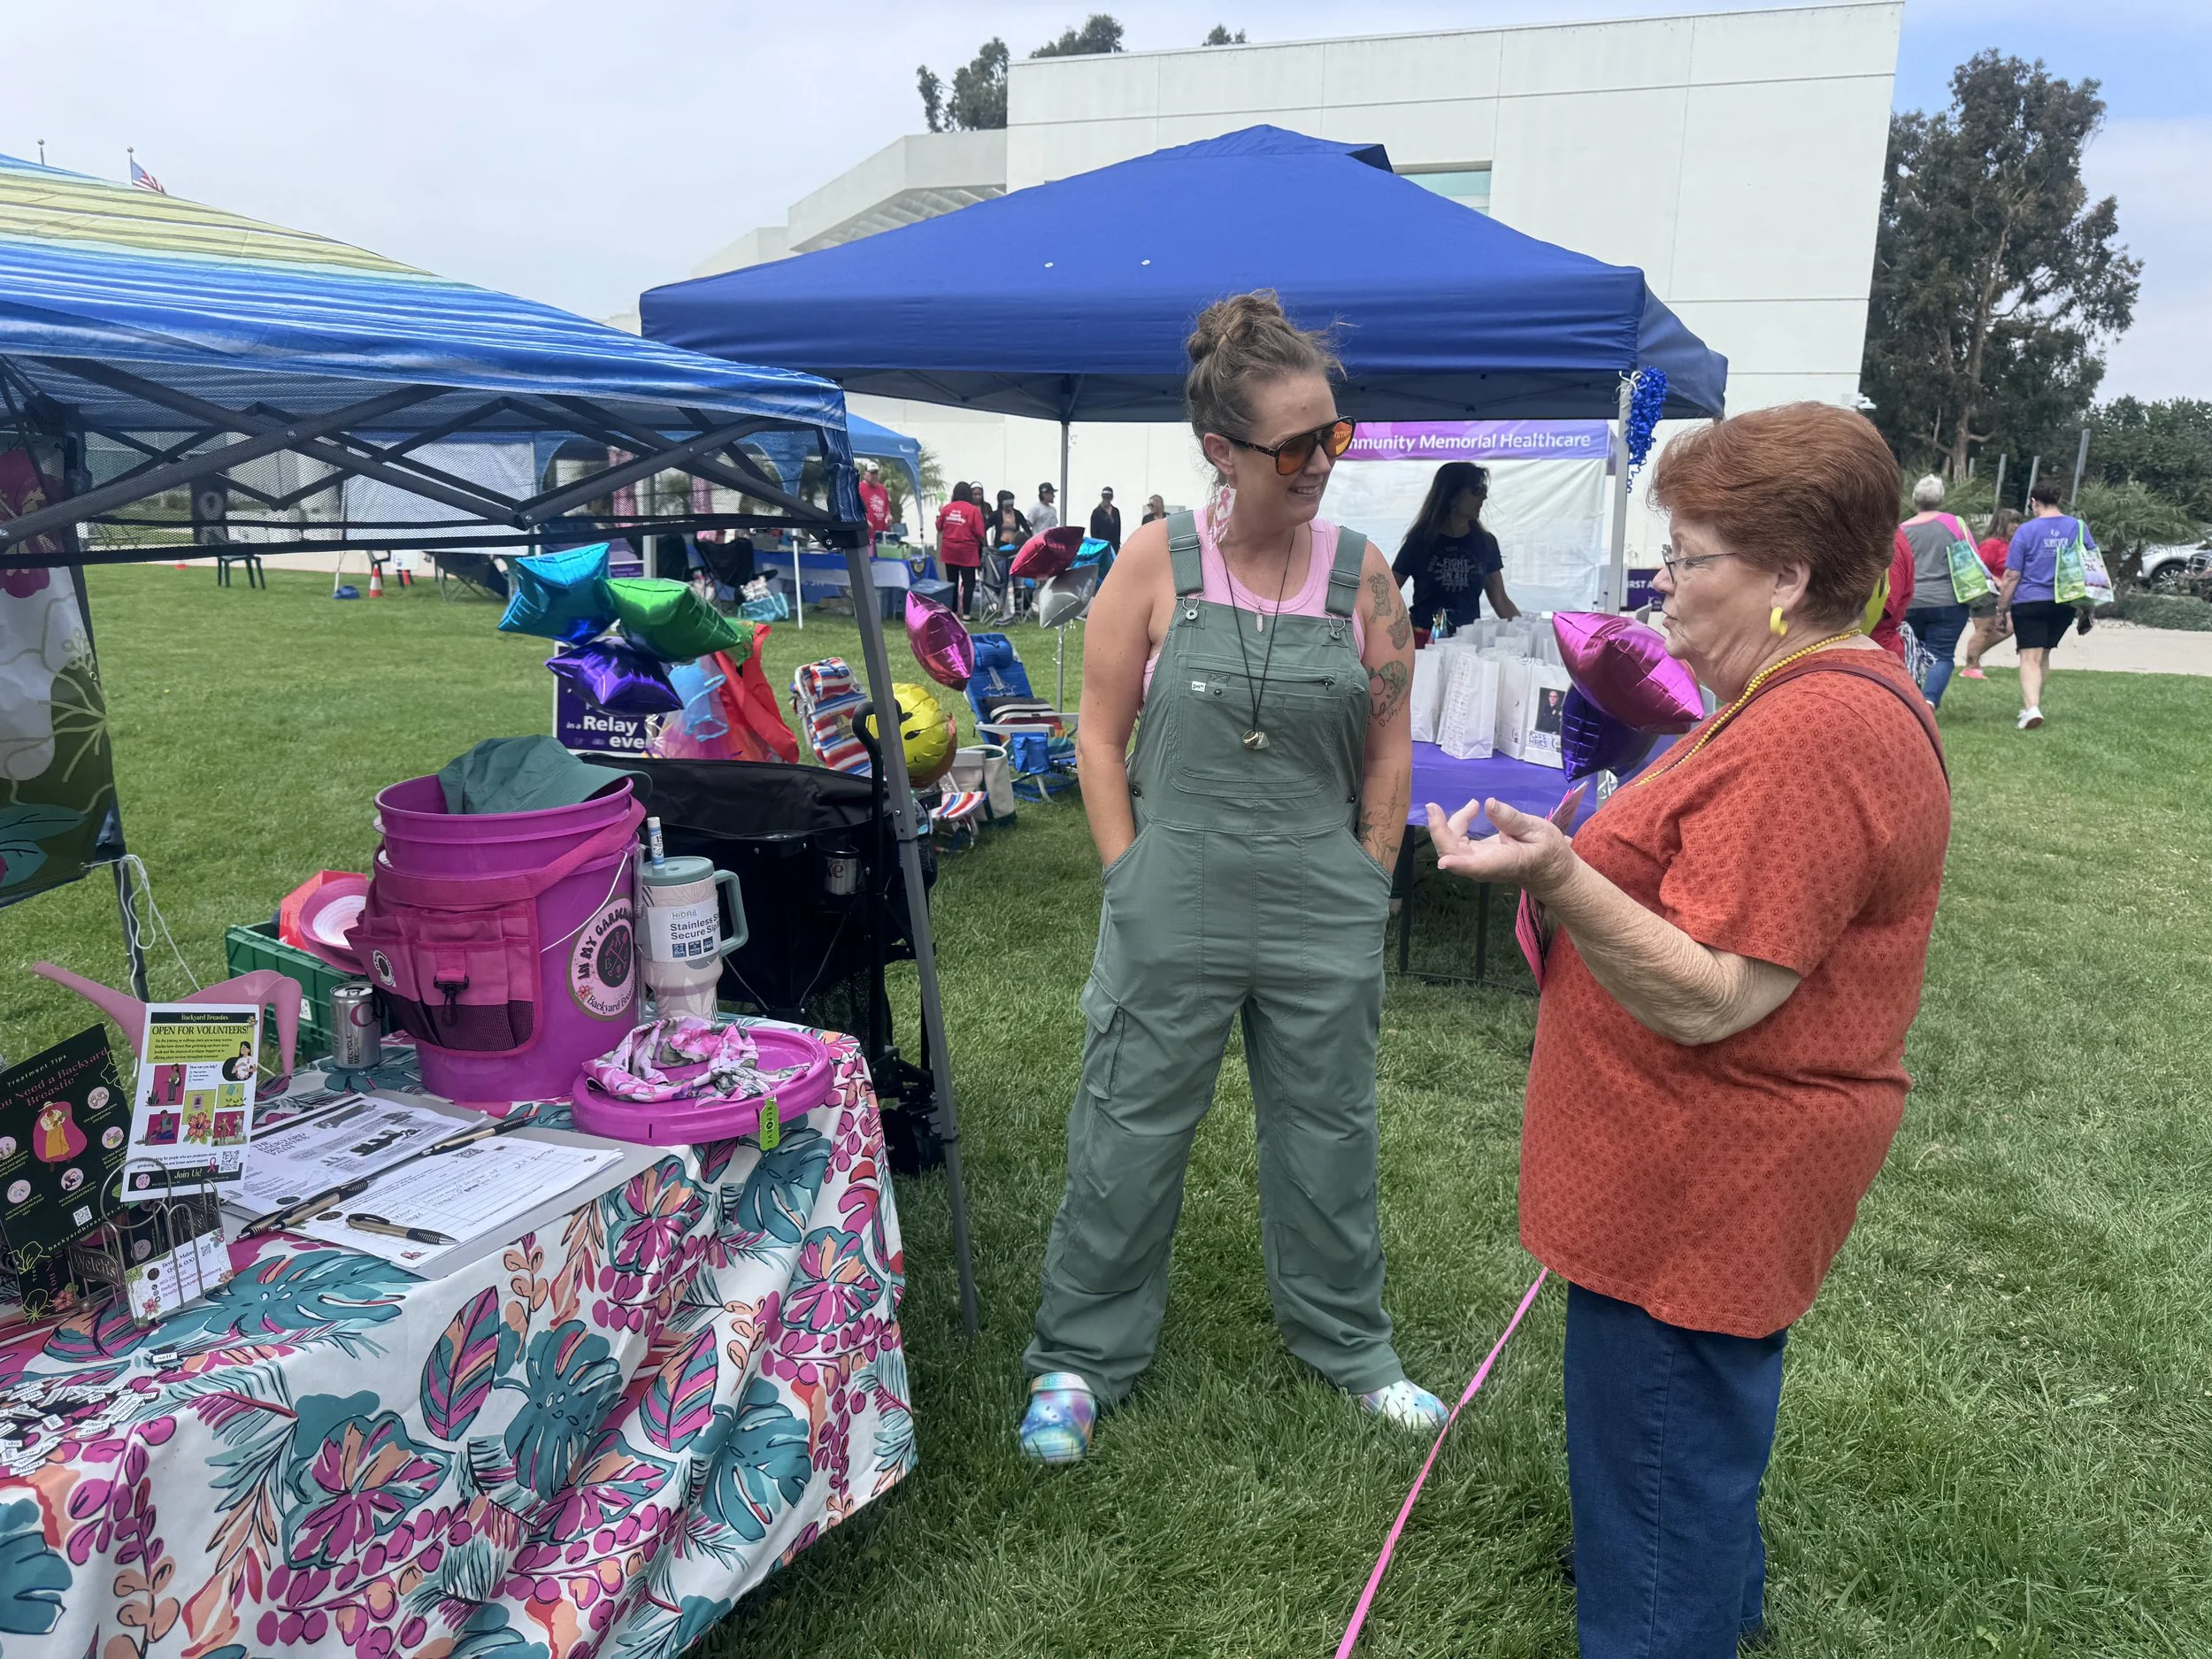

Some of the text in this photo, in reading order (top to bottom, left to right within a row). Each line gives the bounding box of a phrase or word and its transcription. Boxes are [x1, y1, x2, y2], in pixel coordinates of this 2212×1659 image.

[1419, 434, 1496, 449] Memorial
[1500, 432, 1591, 448] Healthcare
[1443, 557, 1469, 566] FIGHT
[583, 715, 638, 737] Relay
[670, 918, 713, 932] Stainless
[671, 929, 706, 941] Secure
[580, 935, 598, 961] MY
[577, 962, 591, 980] IN
[587, 995, 621, 1015] Backyard
[151, 1025, 249, 1035] OPEN FOR VOLUNTEERS!
[7, 1054, 67, 1087] Treatment Tips
[57, 1047, 108, 1079] Backyard
[191, 1168, 203, 1178] Us!
[48, 1202, 130, 1252] backyardbreastes.org
[73, 1253, 117, 1278] Welch's
